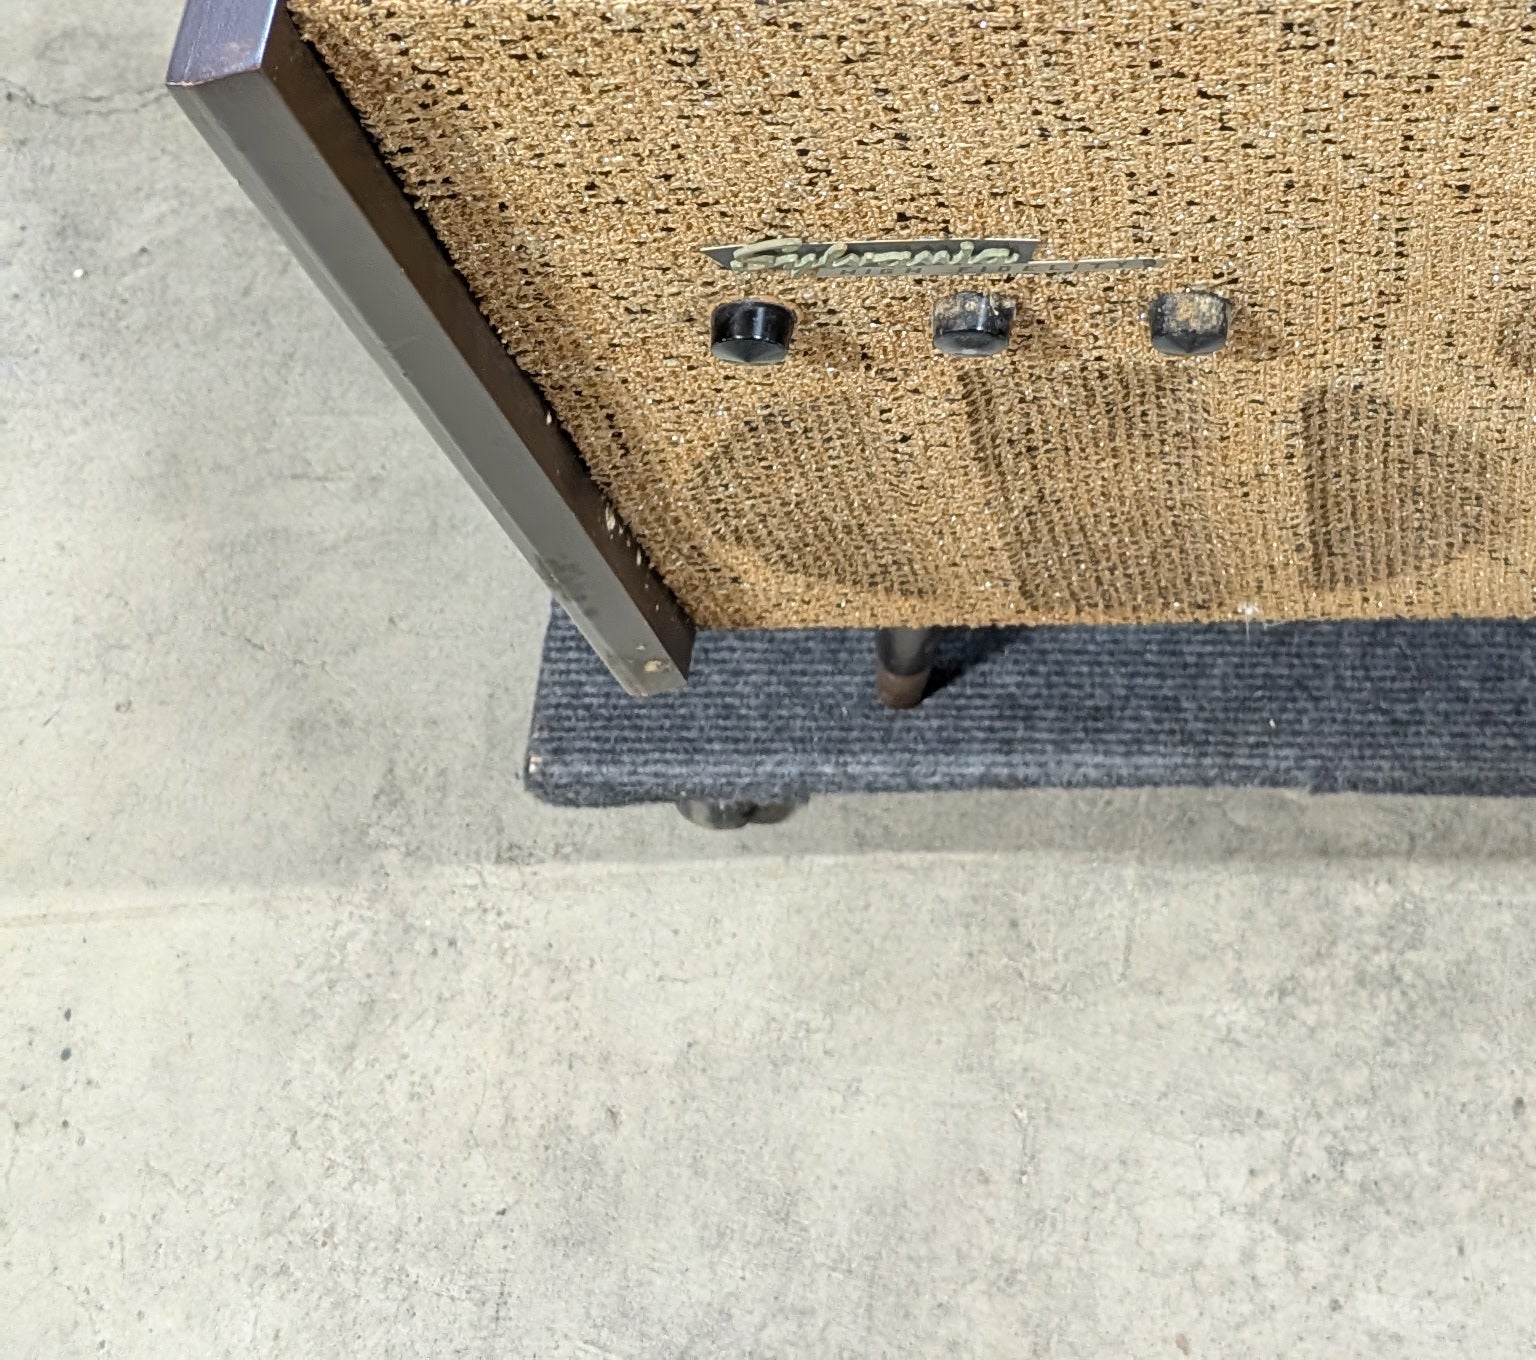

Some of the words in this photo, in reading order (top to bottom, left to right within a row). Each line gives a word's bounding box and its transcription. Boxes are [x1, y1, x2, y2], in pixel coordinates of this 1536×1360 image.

[730, 236, 1020, 277] Sylvania
[839, 266, 922, 275] HIGH
[957, 259, 1128, 274] FIDELITY
